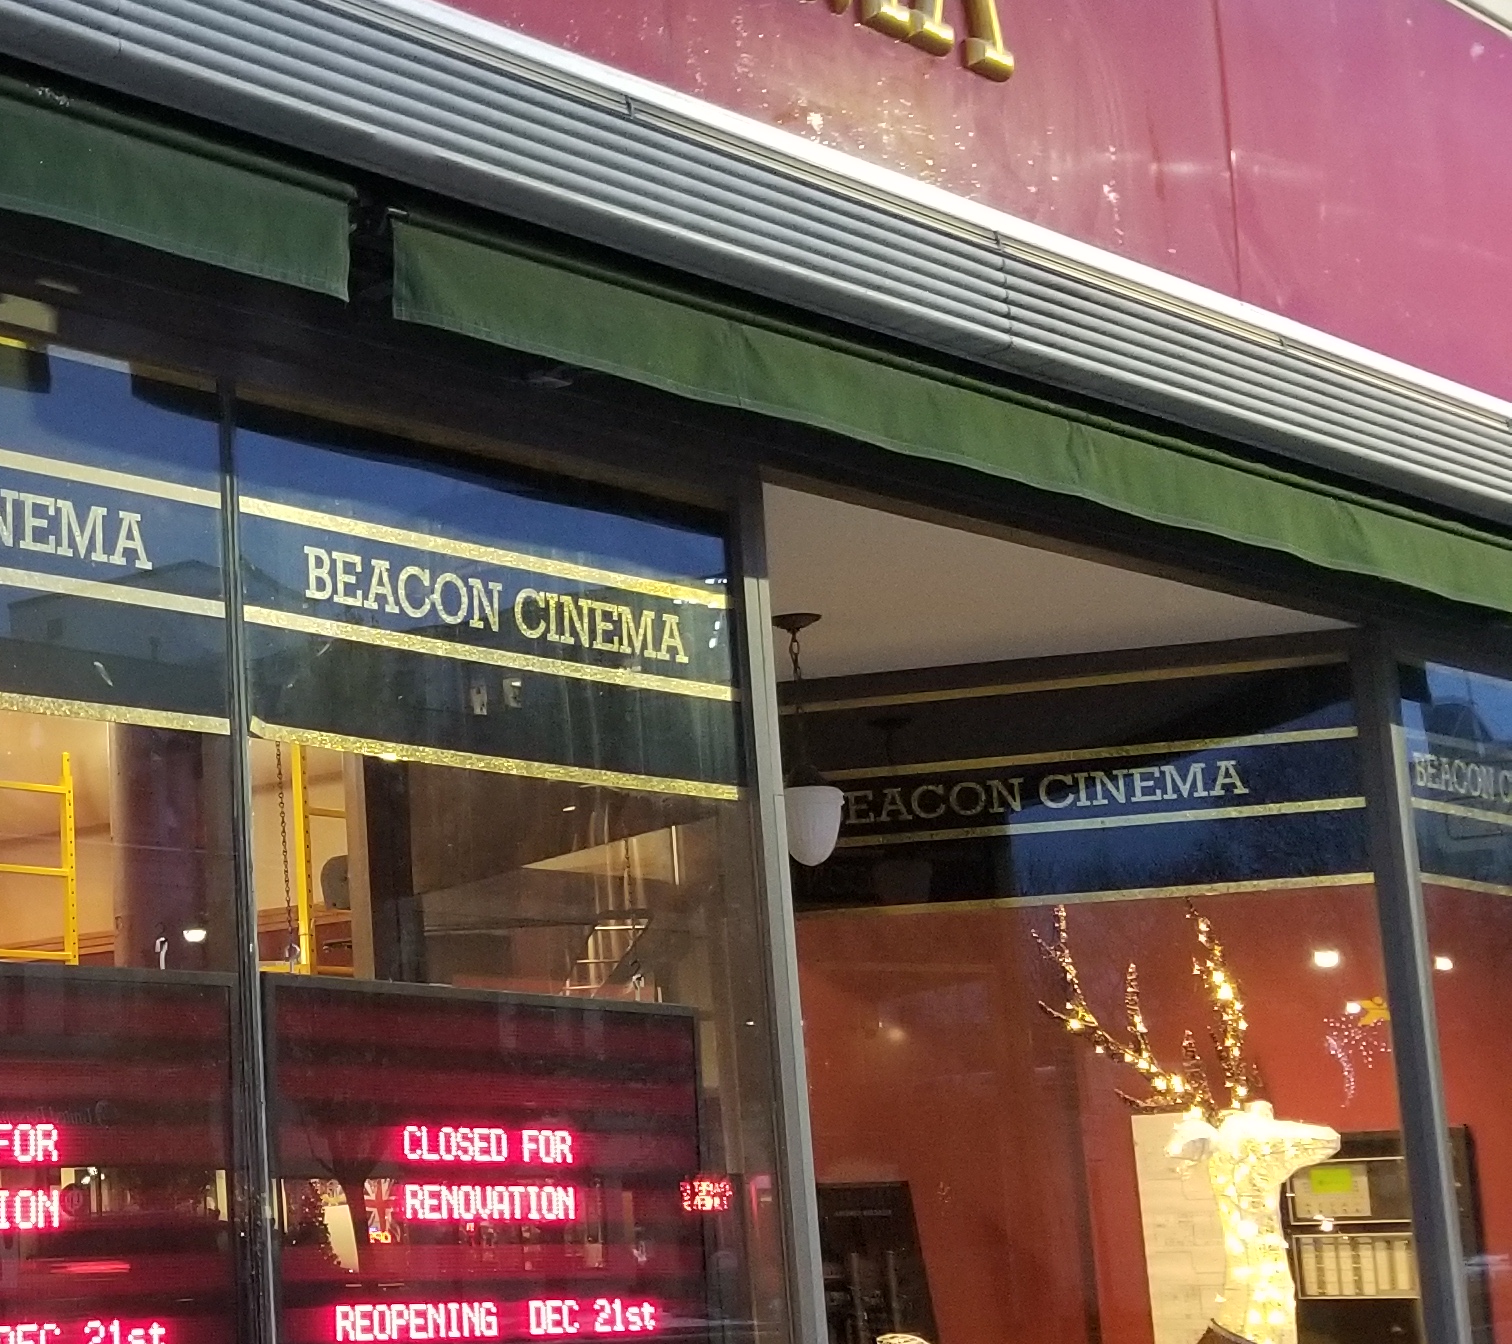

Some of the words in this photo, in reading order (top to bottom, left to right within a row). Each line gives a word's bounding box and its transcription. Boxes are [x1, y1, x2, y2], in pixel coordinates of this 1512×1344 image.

[304, 546, 502, 632] BEACON
[514, 588, 689, 664] CINEMA
[843, 777, 1024, 825] EACON
[1038, 760, 1249, 809] CINEMA
[1412, 751, 1494, 800] BEACON
[403, 1125, 508, 1162] CLOSED
[521, 1128, 573, 1163] FOR
[404, 1185, 576, 1220] RENOVATION
[336, 1301, 499, 1342] REOPENING
[528, 1299, 580, 1335] DEC
[593, 1298, 657, 1332] 21st
